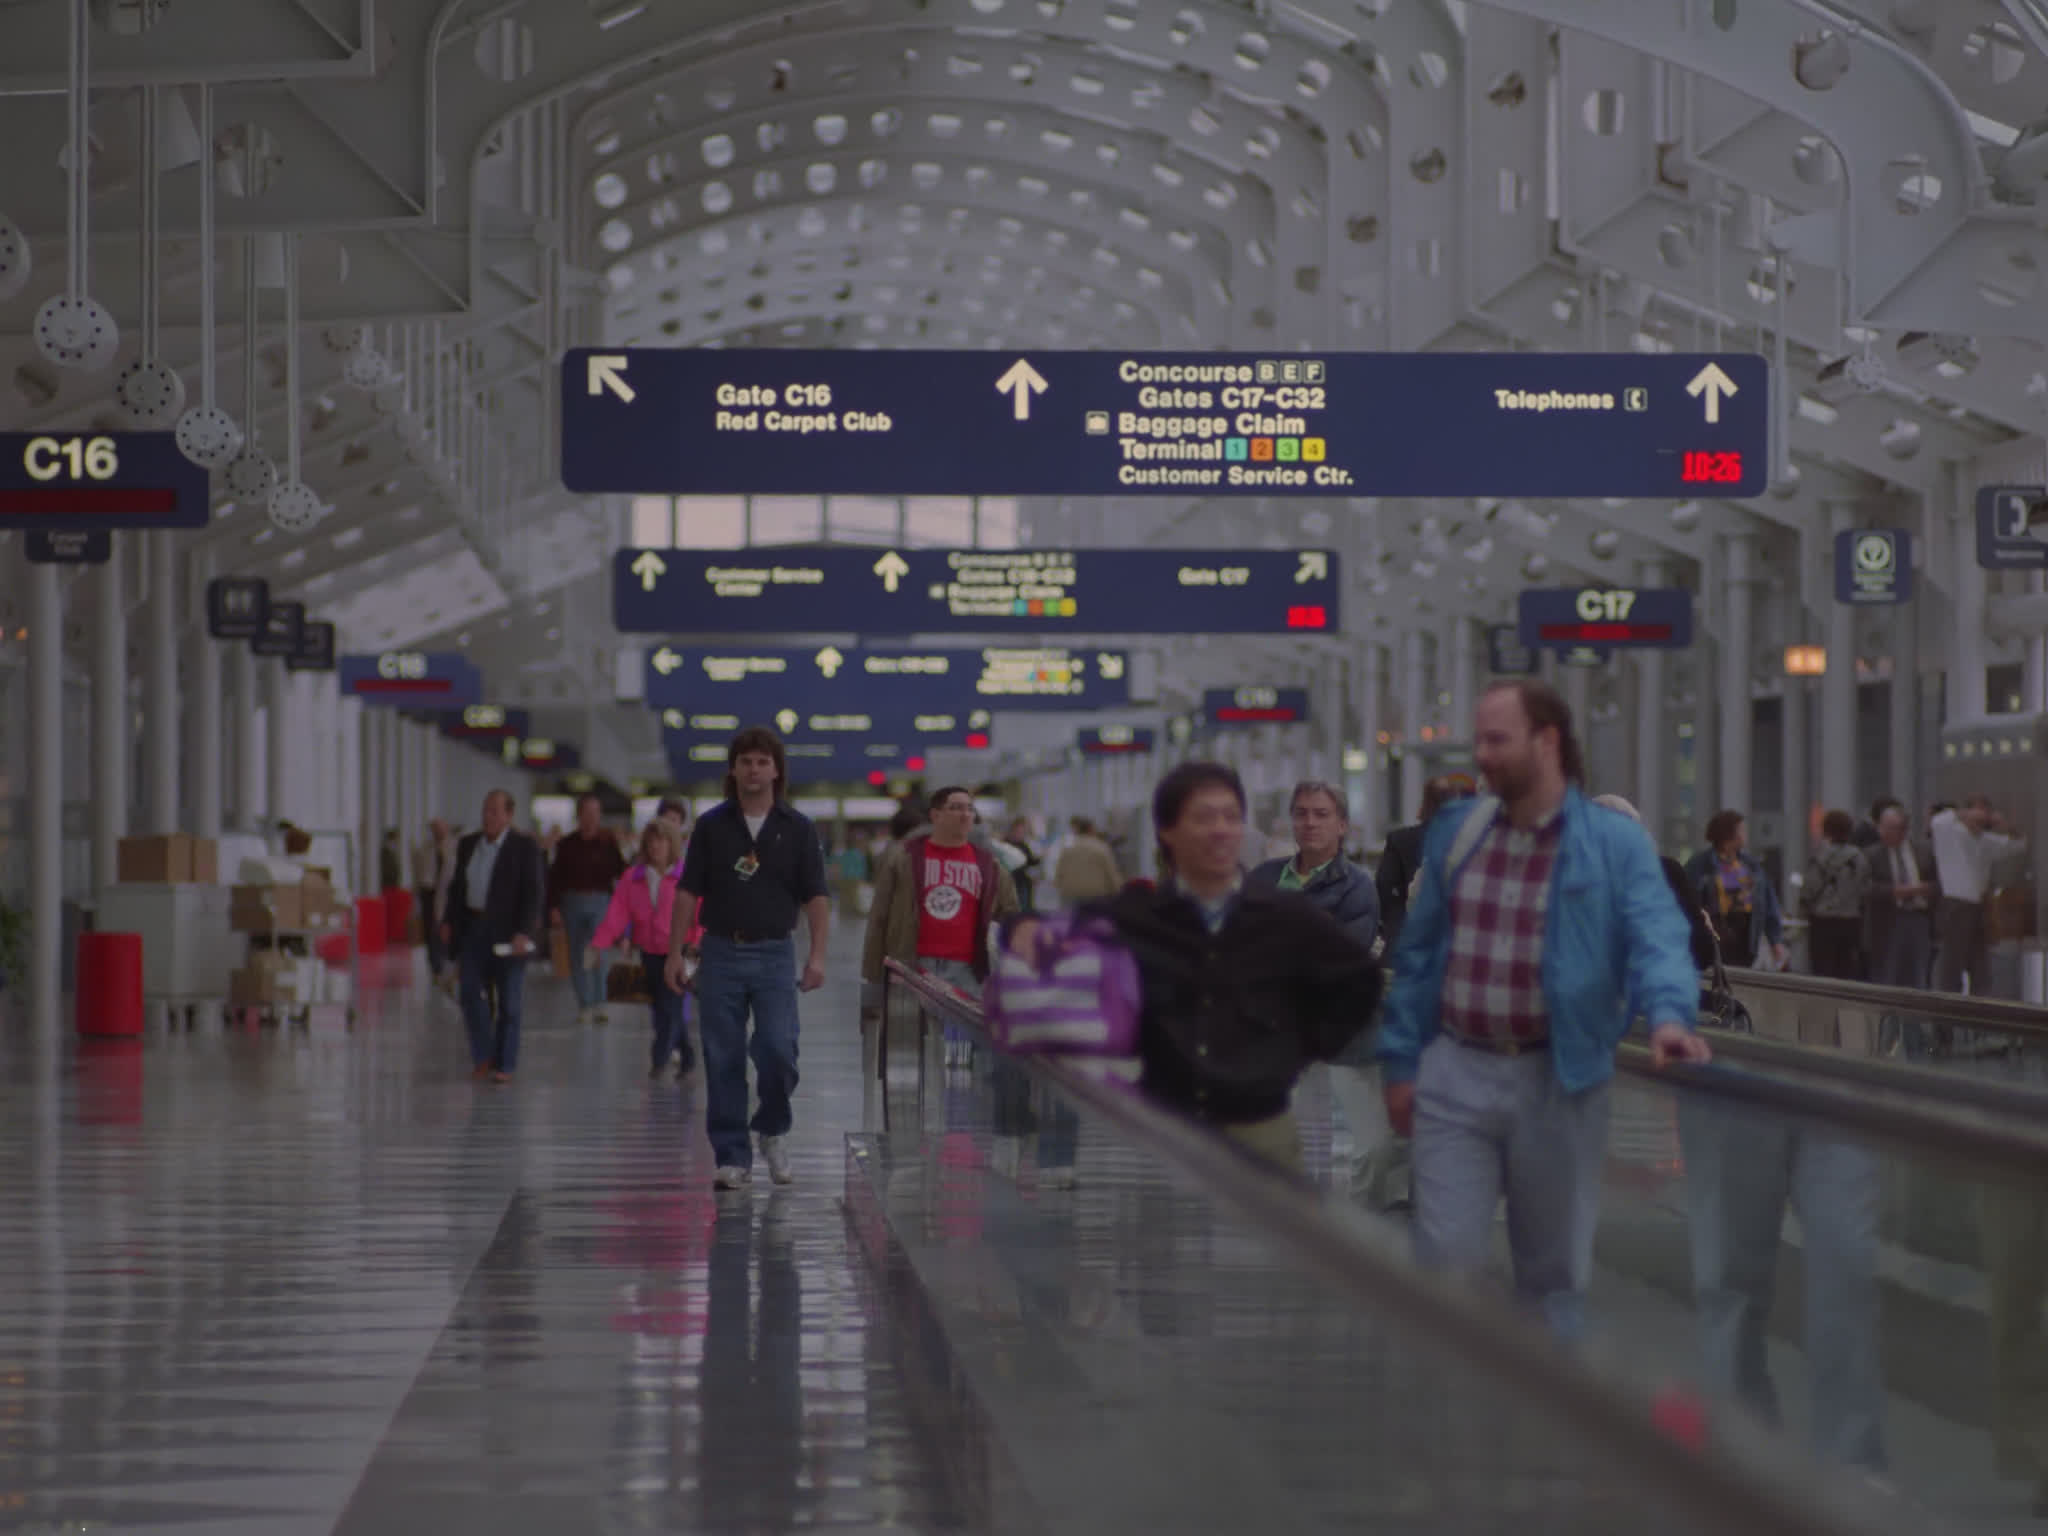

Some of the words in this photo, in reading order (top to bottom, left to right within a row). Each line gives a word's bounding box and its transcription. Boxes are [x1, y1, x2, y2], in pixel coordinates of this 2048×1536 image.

[1120, 361, 1253, 382] Concourse
[1259, 364, 1275, 380] B
[1283, 364, 1298, 380] E
[1306, 364, 1320, 380] F
[717, 384, 776, 406] Gate
[785, 384, 831, 406] C16
[1139, 387, 1213, 408] Gates
[1222, 387, 1325, 409] C17-C32
[1495, 390, 1614, 412] Telephones
[717, 412, 758, 430] Red
[764, 411, 836, 433] Carpet
[843, 412, 892, 431] Club
[1119, 413, 1228, 437] Baggage
[1236, 413, 1305, 434] Claim
[24, 437, 117, 480] C16
[1119, 439, 1222, 460] Terminal
[1119, 465, 1221, 484] Customer
[1228, 466, 1307, 485] Service
[1314, 466, 1353, 485] Ctr.
[1576, 590, 1635, 620] C17
